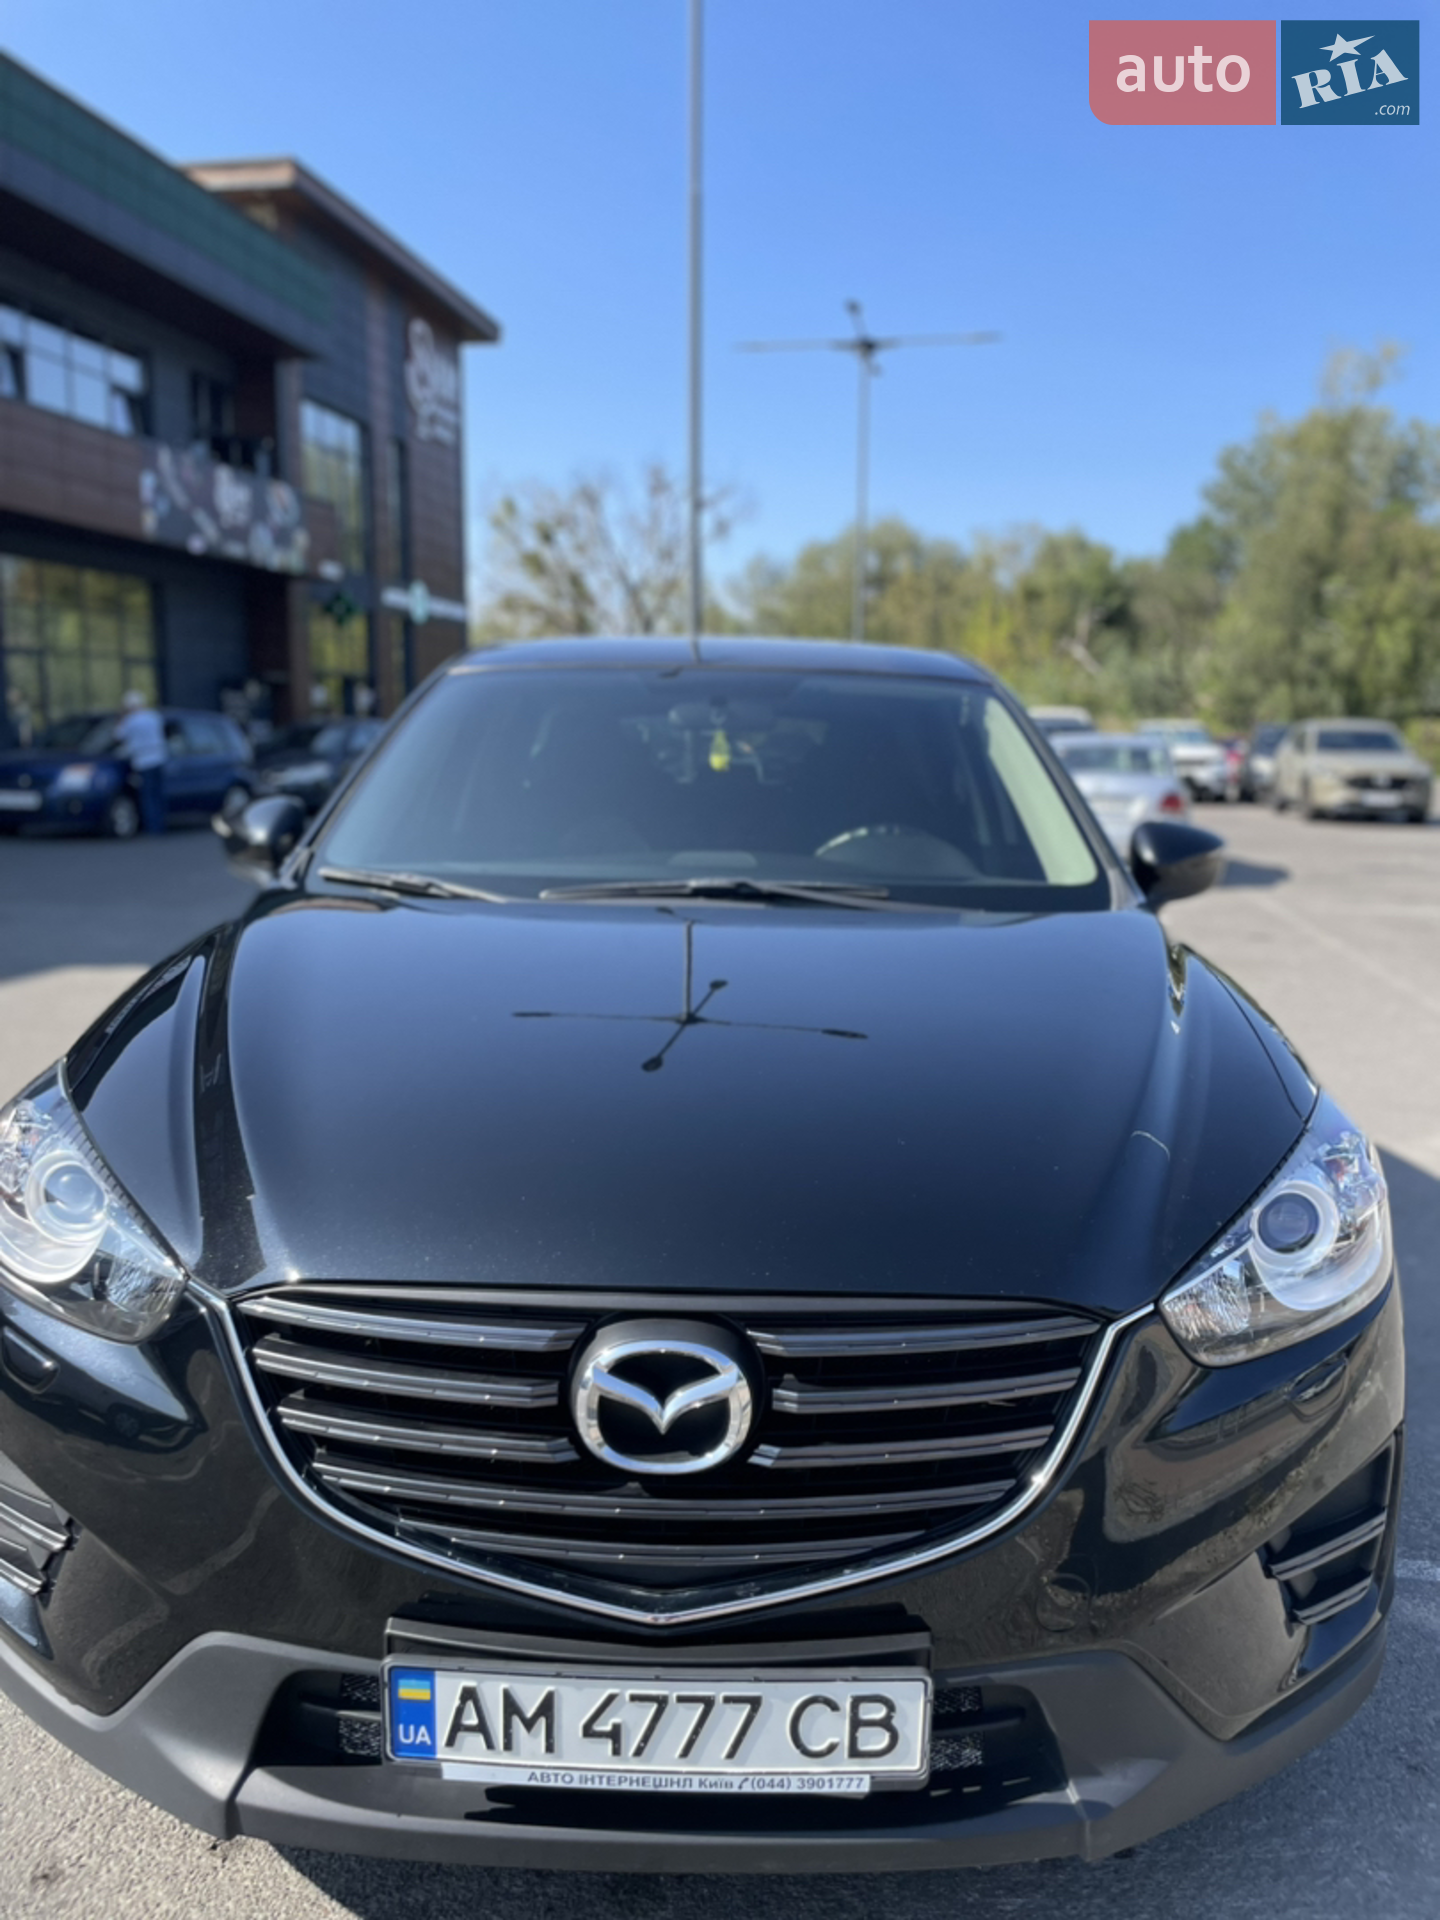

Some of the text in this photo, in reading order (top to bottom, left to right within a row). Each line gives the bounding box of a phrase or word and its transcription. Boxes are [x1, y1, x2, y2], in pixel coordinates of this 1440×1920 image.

[443, 1683, 900, 1760] AM 4777 CB
[398, 1723, 432, 1746] UA
[527, 1771, 575, 1785] АВТО
[698, 1777, 734, 1790] Київ
[751, 1777, 792, 1790] (044)
[796, 1776, 865, 1790] 3901777
